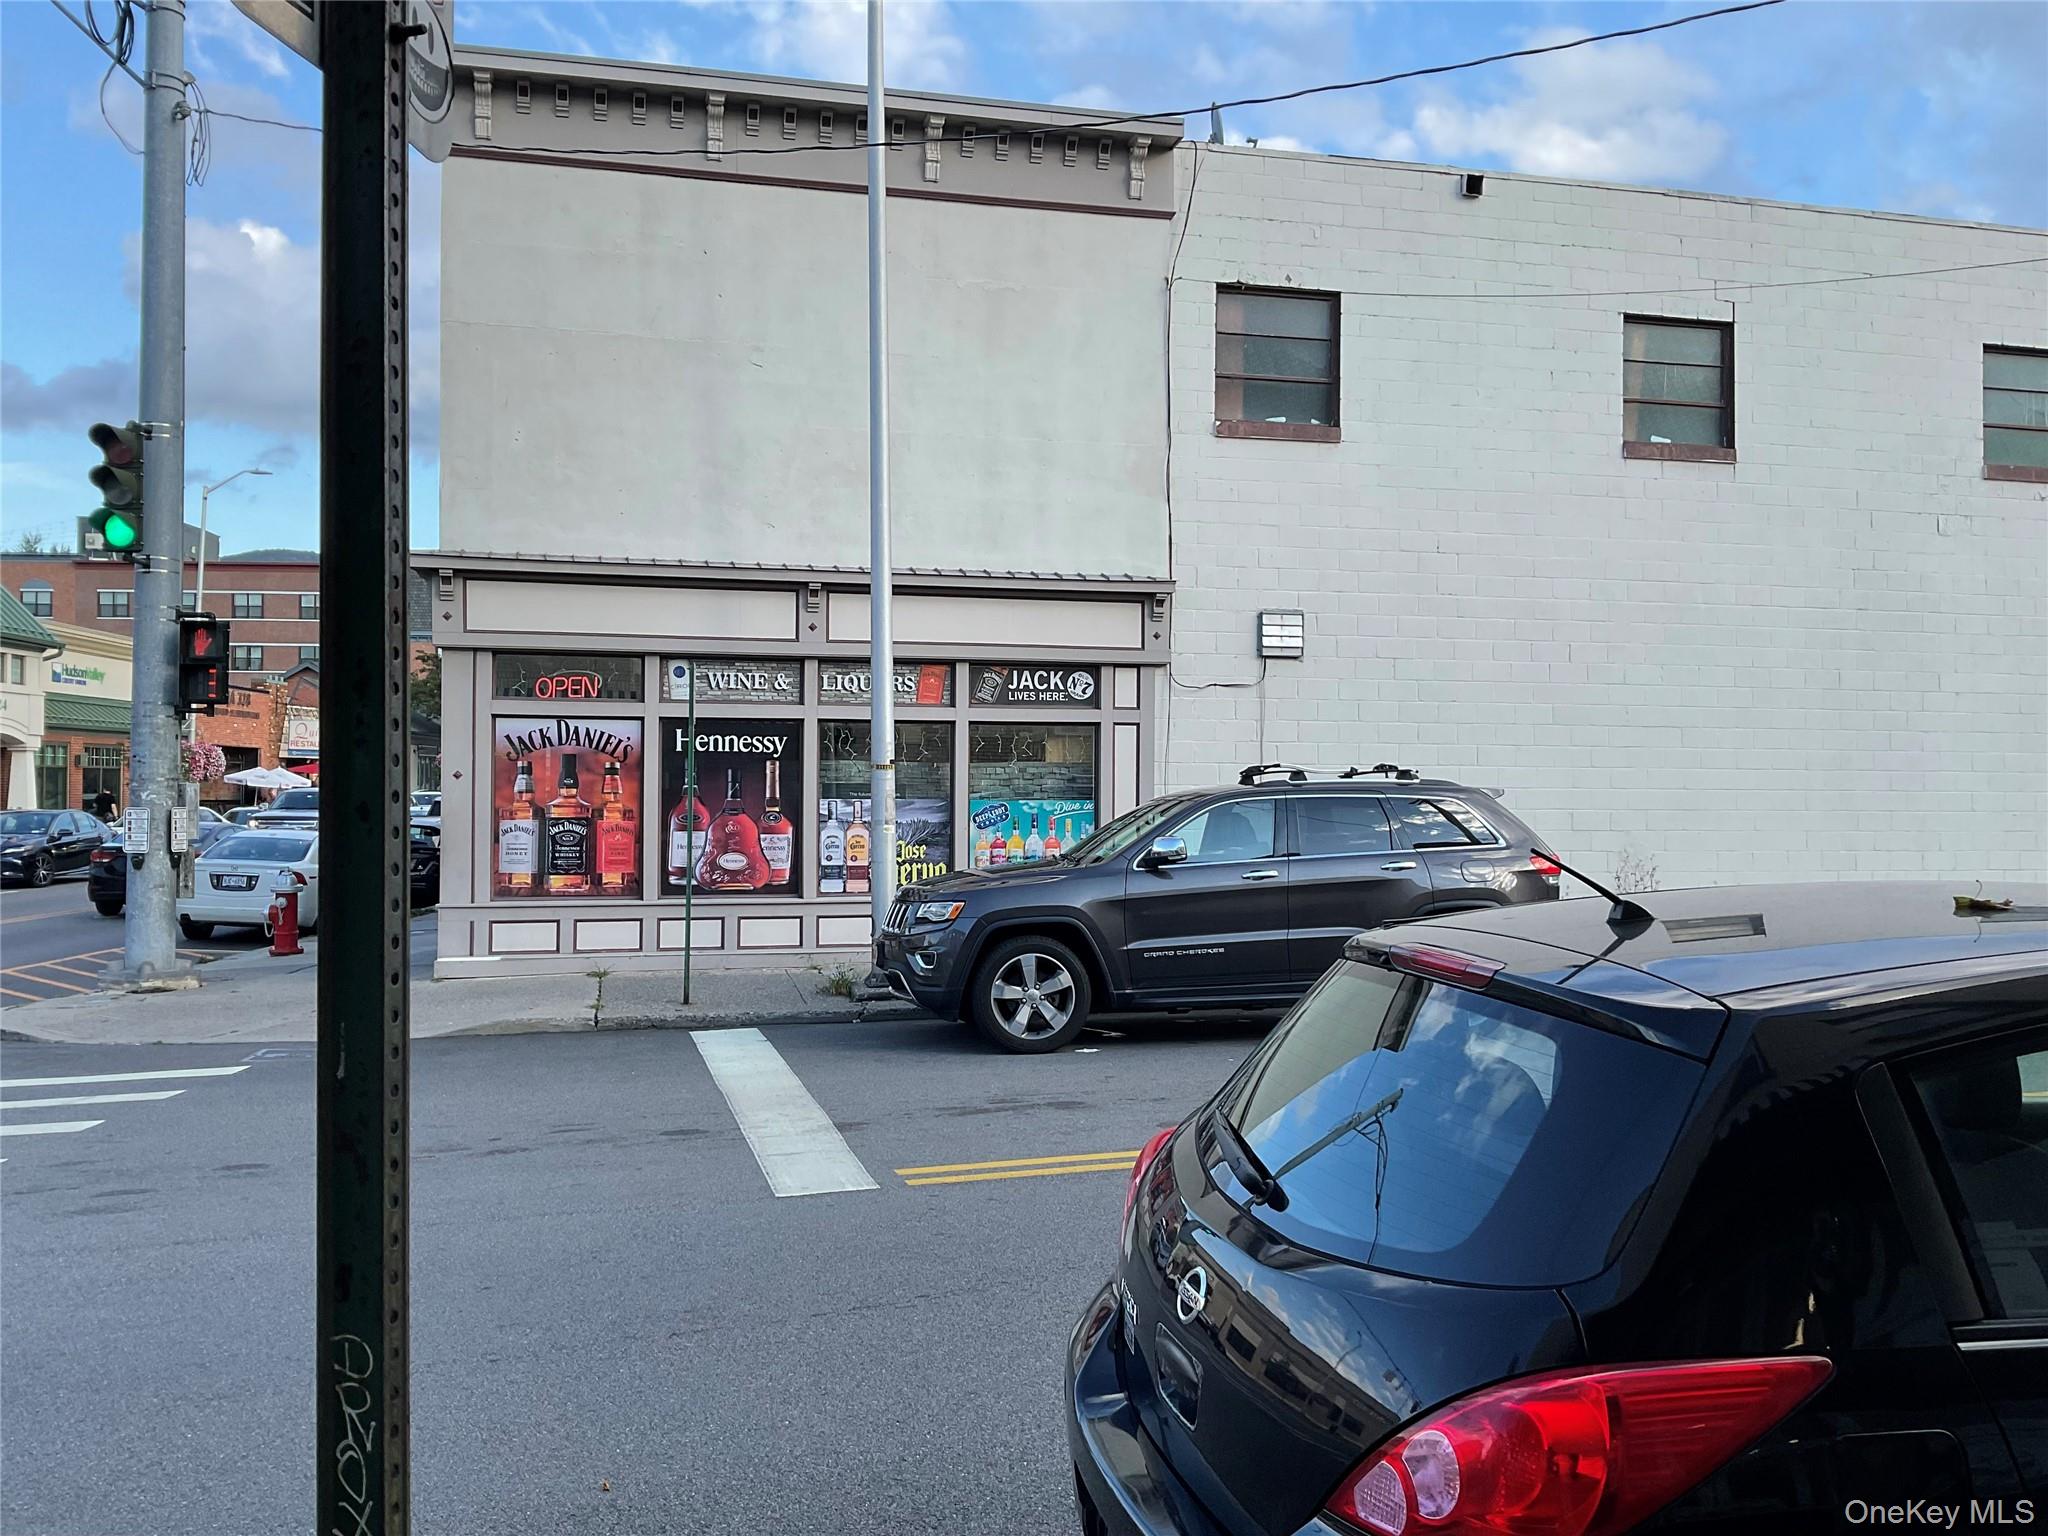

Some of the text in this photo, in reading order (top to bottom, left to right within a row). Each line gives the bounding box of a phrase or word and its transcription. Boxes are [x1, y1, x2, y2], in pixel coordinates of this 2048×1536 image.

[535, 676, 598, 699] OPEN
[707, 672, 793, 690] WINE &
[821, 674, 916, 693] LIQURS
[1008, 670, 1065, 690] JACK
[1008, 691, 1036, 701] LIVES
[504, 719, 634, 764] JACK DANIEL'S
[675, 728, 788, 758] Hennessy
[1054, 801, 1081, 815] Dive
[549, 824, 564, 836] JACK
[896, 840, 926, 862] Jose
[1176, 947, 1225, 956] CHEROKEE
